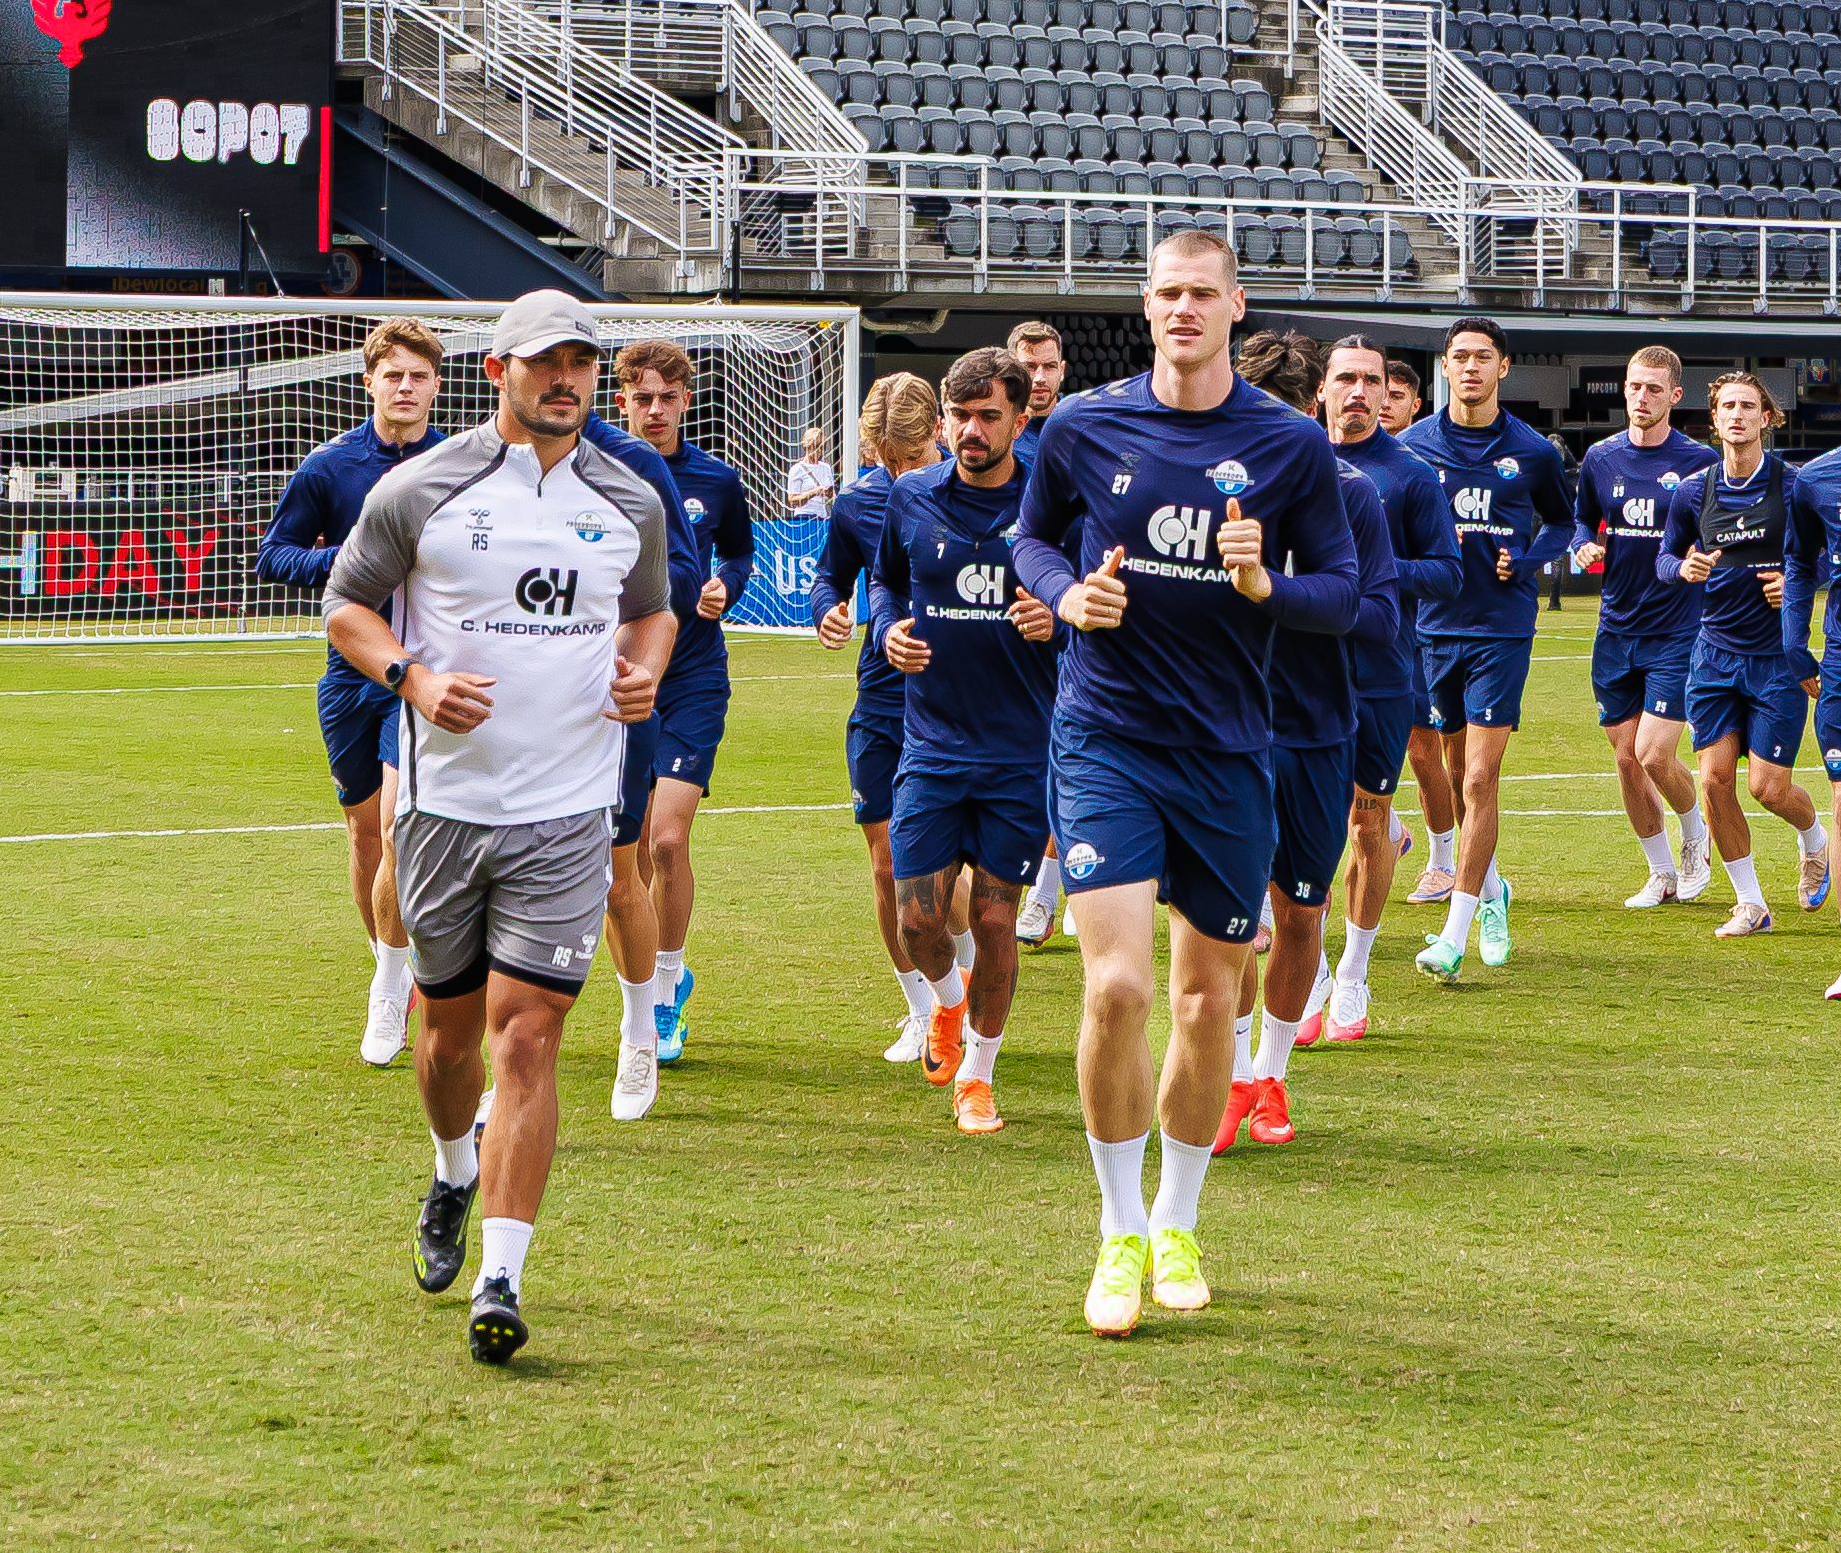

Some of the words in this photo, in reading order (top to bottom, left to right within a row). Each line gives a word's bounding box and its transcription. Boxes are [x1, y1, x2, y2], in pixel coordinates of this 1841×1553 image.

[1112, 473, 1133, 495] 27
[471, 533, 489, 551] RS
[1716, 528, 1766, 543] CATAPULT
[936, 542, 946, 560] 7
[774, 549, 818, 595] US
[1119, 556, 1232, 583] HEDENKAM
[939, 607, 1014, 621] HEDENKA
[460, 619, 480, 633] C.
[485, 621, 606, 637] HEDENKAMP
[1484, 707, 1493, 721] 5
[1772, 745, 1782, 758] 3
[671, 757, 682, 773] 2
[1379, 778, 1388, 791] 9
[1019, 860, 1031, 876] 7
[1295, 880, 1312, 899] 38
[1226, 917, 1249, 936] 27
[551, 945, 572, 968] RS
